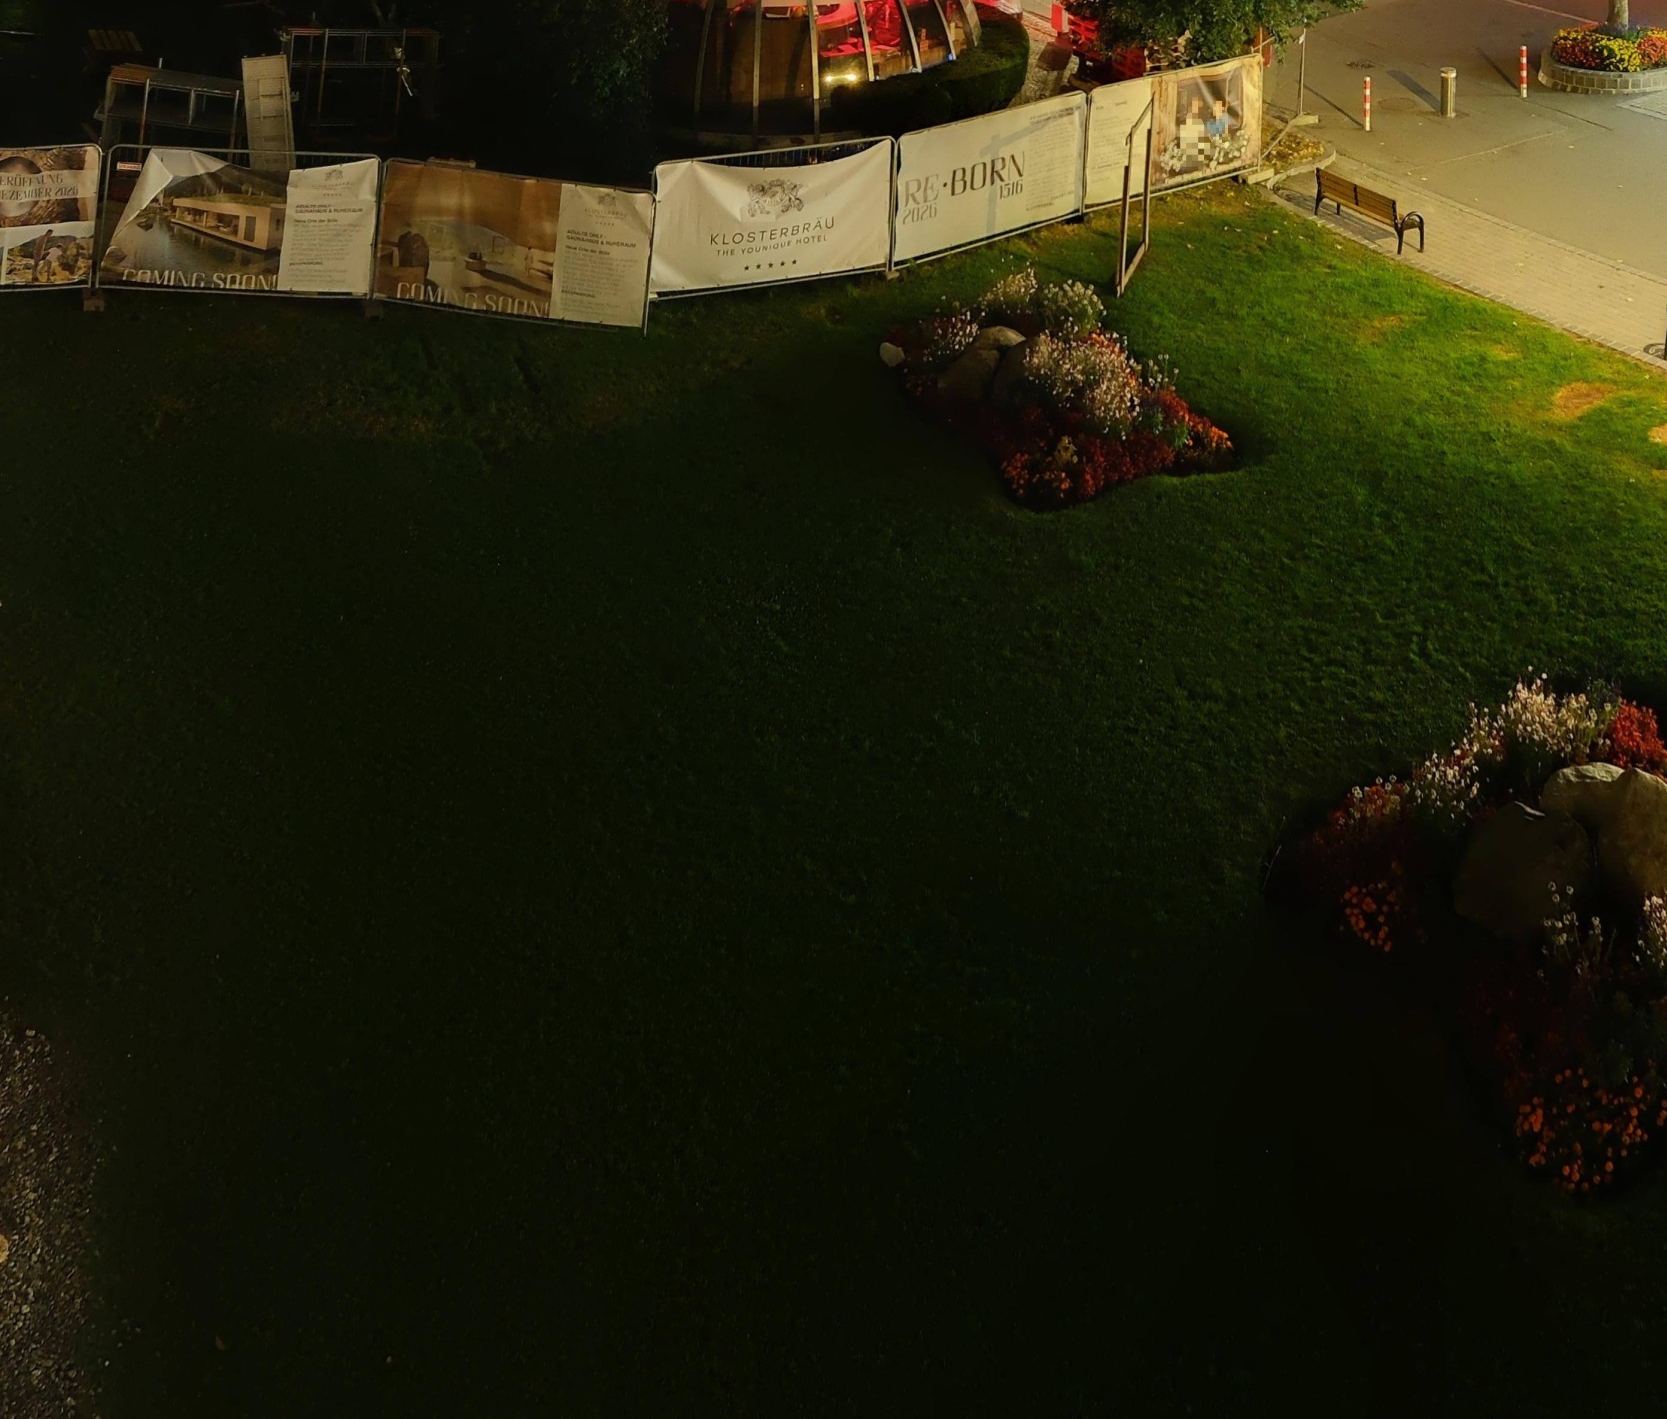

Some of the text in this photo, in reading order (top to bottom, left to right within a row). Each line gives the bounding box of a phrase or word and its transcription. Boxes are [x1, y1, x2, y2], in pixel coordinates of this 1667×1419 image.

[0, 187, 52, 201] EZEMBER
[902, 202, 937, 225] 2026
[709, 216, 836, 246] KLOSTERBRÄU
[716, 234, 828, 257] THE YOUNIQUE HOTEL
[122, 268, 205, 288] COMING
[396, 282, 479, 311] COMING
